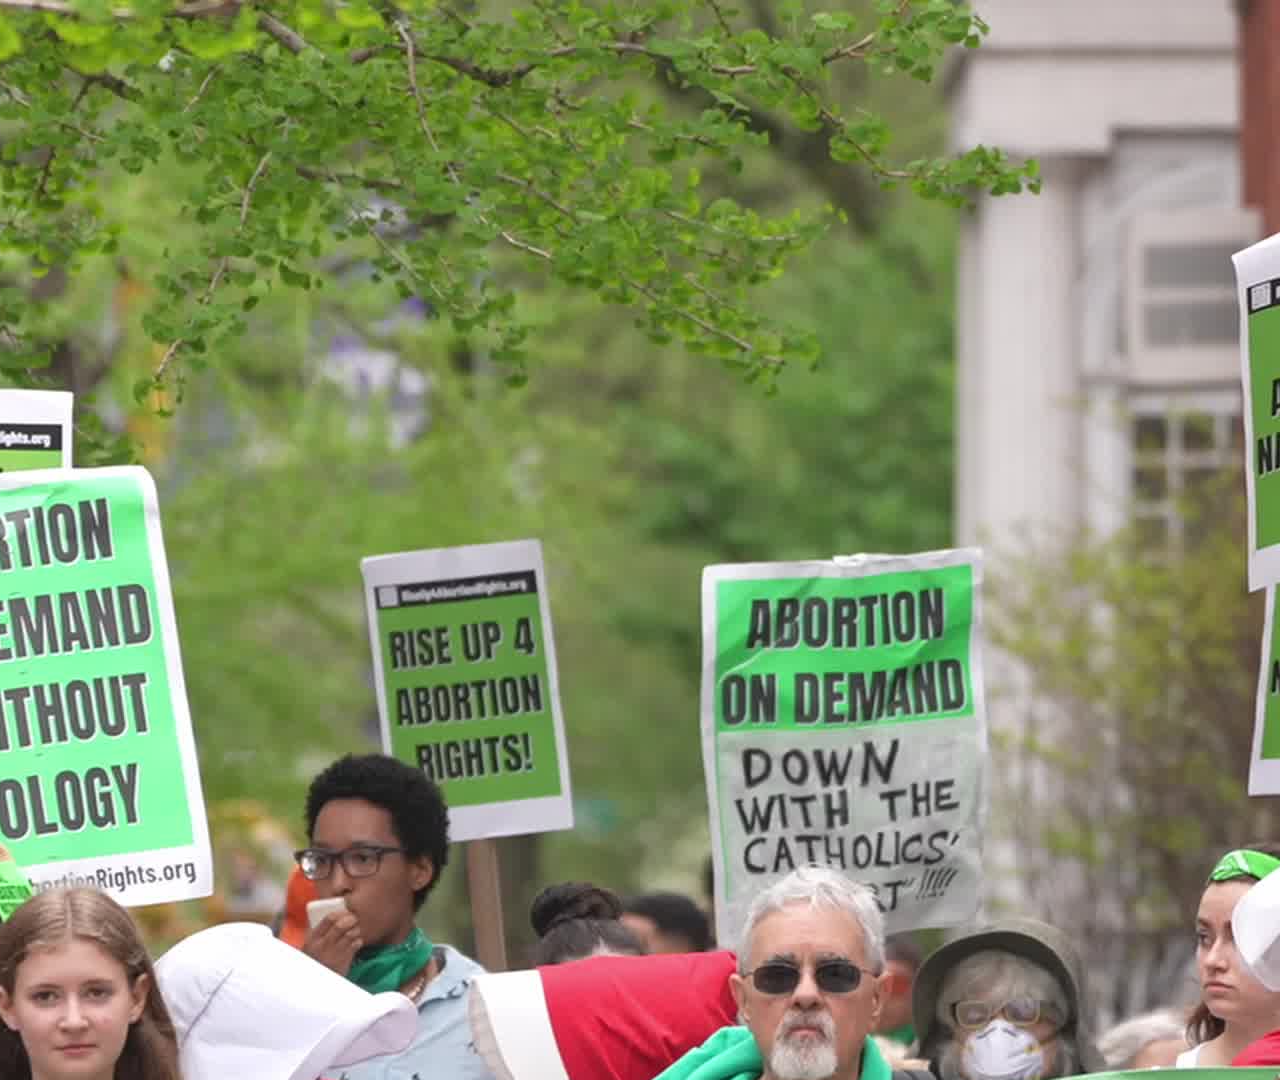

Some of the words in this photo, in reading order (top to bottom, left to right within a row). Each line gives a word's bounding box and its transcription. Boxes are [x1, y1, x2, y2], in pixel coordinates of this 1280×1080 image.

[388, 625, 453, 670] RISE
[460, 620, 501, 662] UP
[513, 616, 535, 656] 4
[745, 588, 944, 649] ABORTION
[395, 672, 543, 727] ABORTION
[721, 674, 776, 725] ON
[794, 658, 964, 724] DEMAND
[416, 732, 533, 784] RIGHTS!
[742, 739, 900, 788] DOWN
[735, 789, 849, 835] WITH
[879, 779, 960, 822] THE
